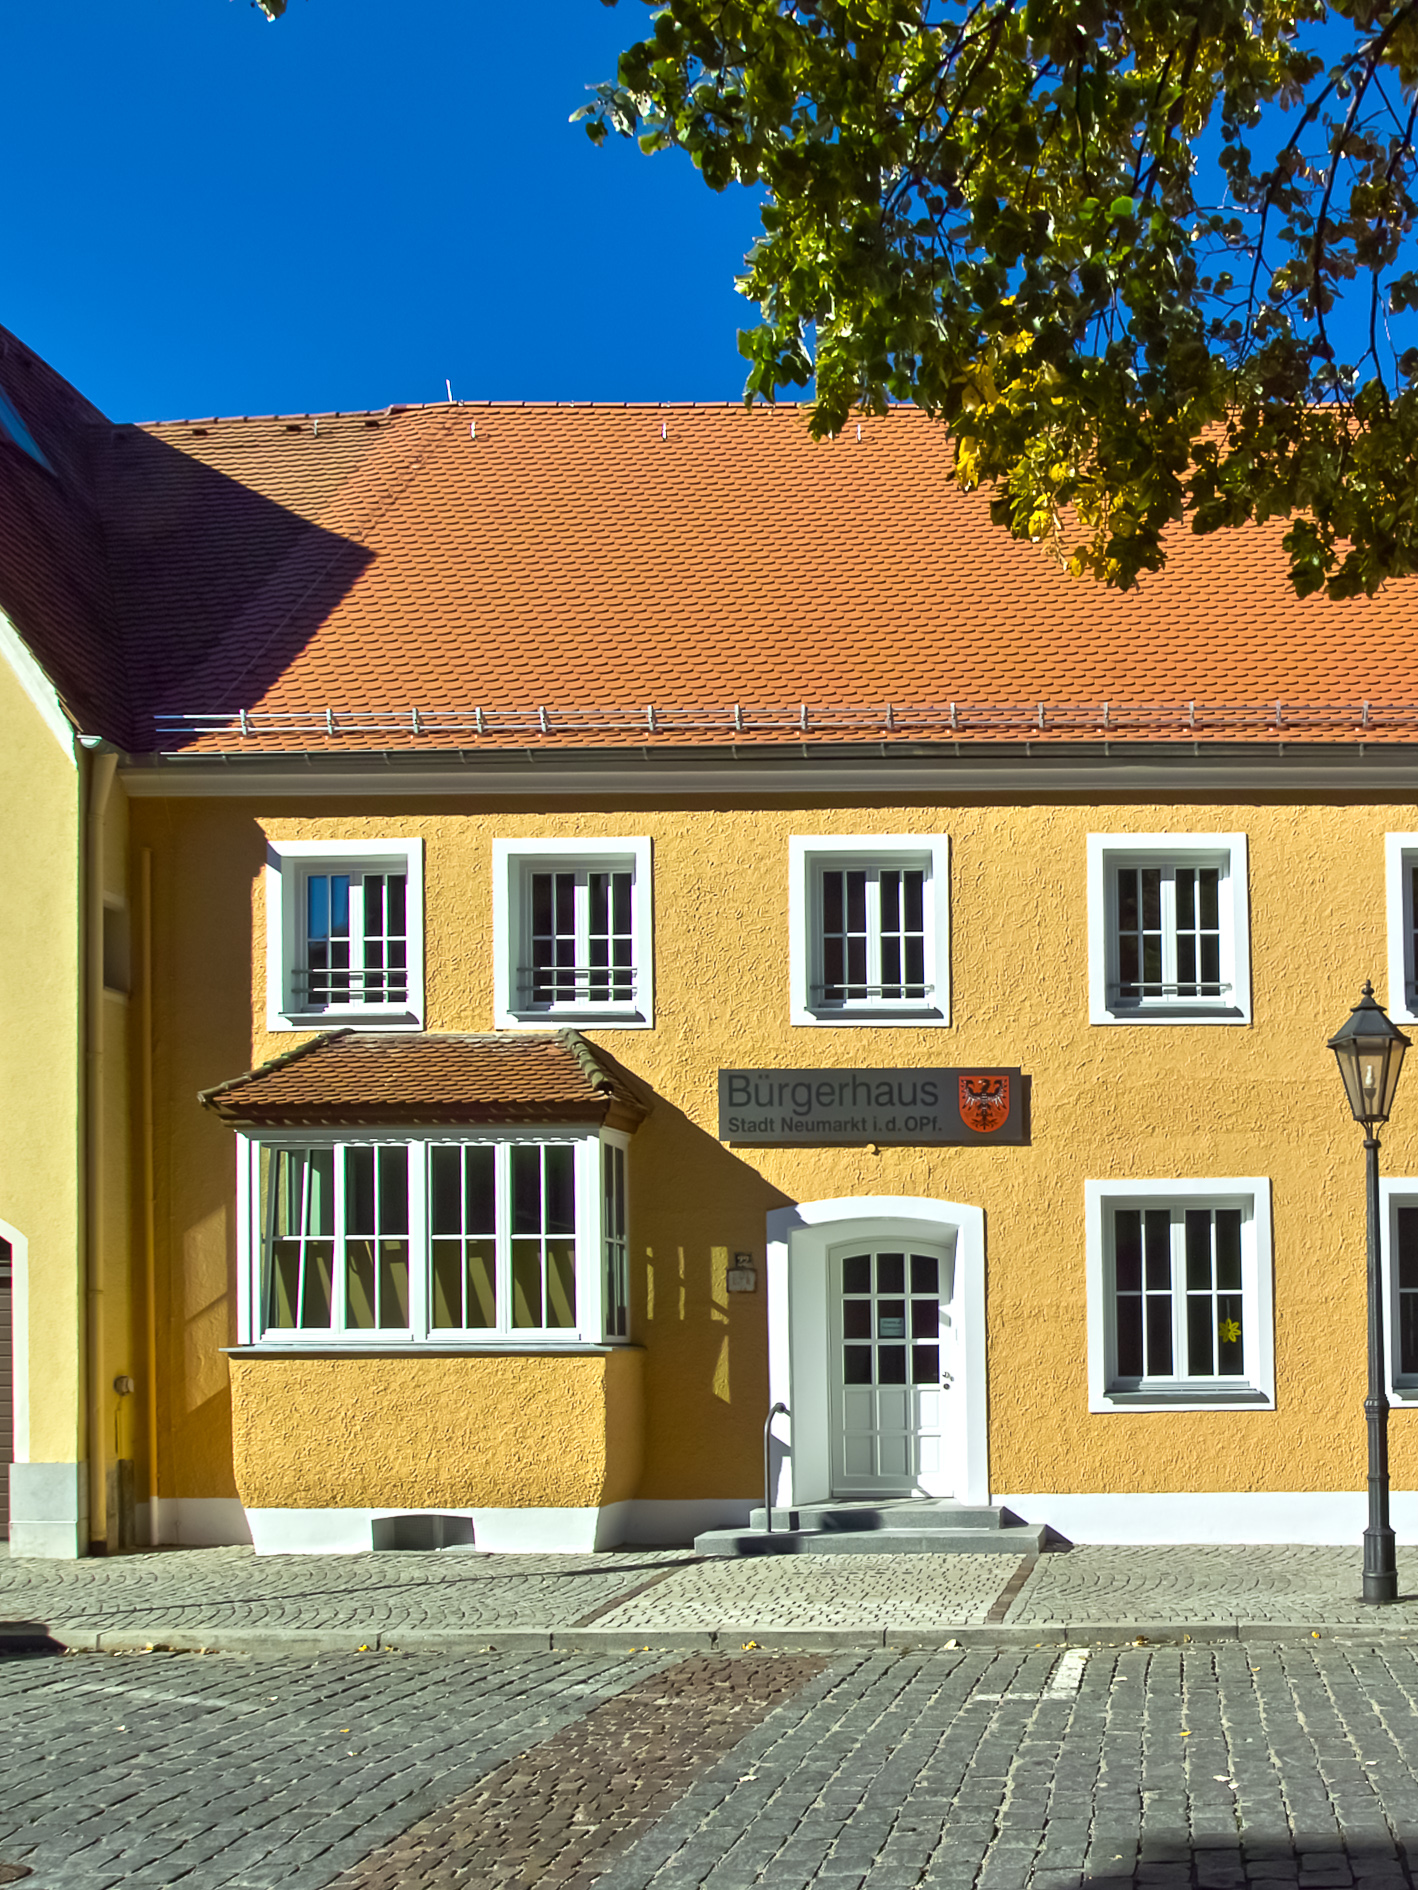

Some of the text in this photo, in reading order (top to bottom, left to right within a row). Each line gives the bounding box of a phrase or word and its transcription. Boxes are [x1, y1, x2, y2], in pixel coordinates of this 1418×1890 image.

[727, 1073, 939, 1116] Bürgerhaus
[728, 1117, 775, 1133] Stadt
[781, 1116, 868, 1133] Neumarkt
